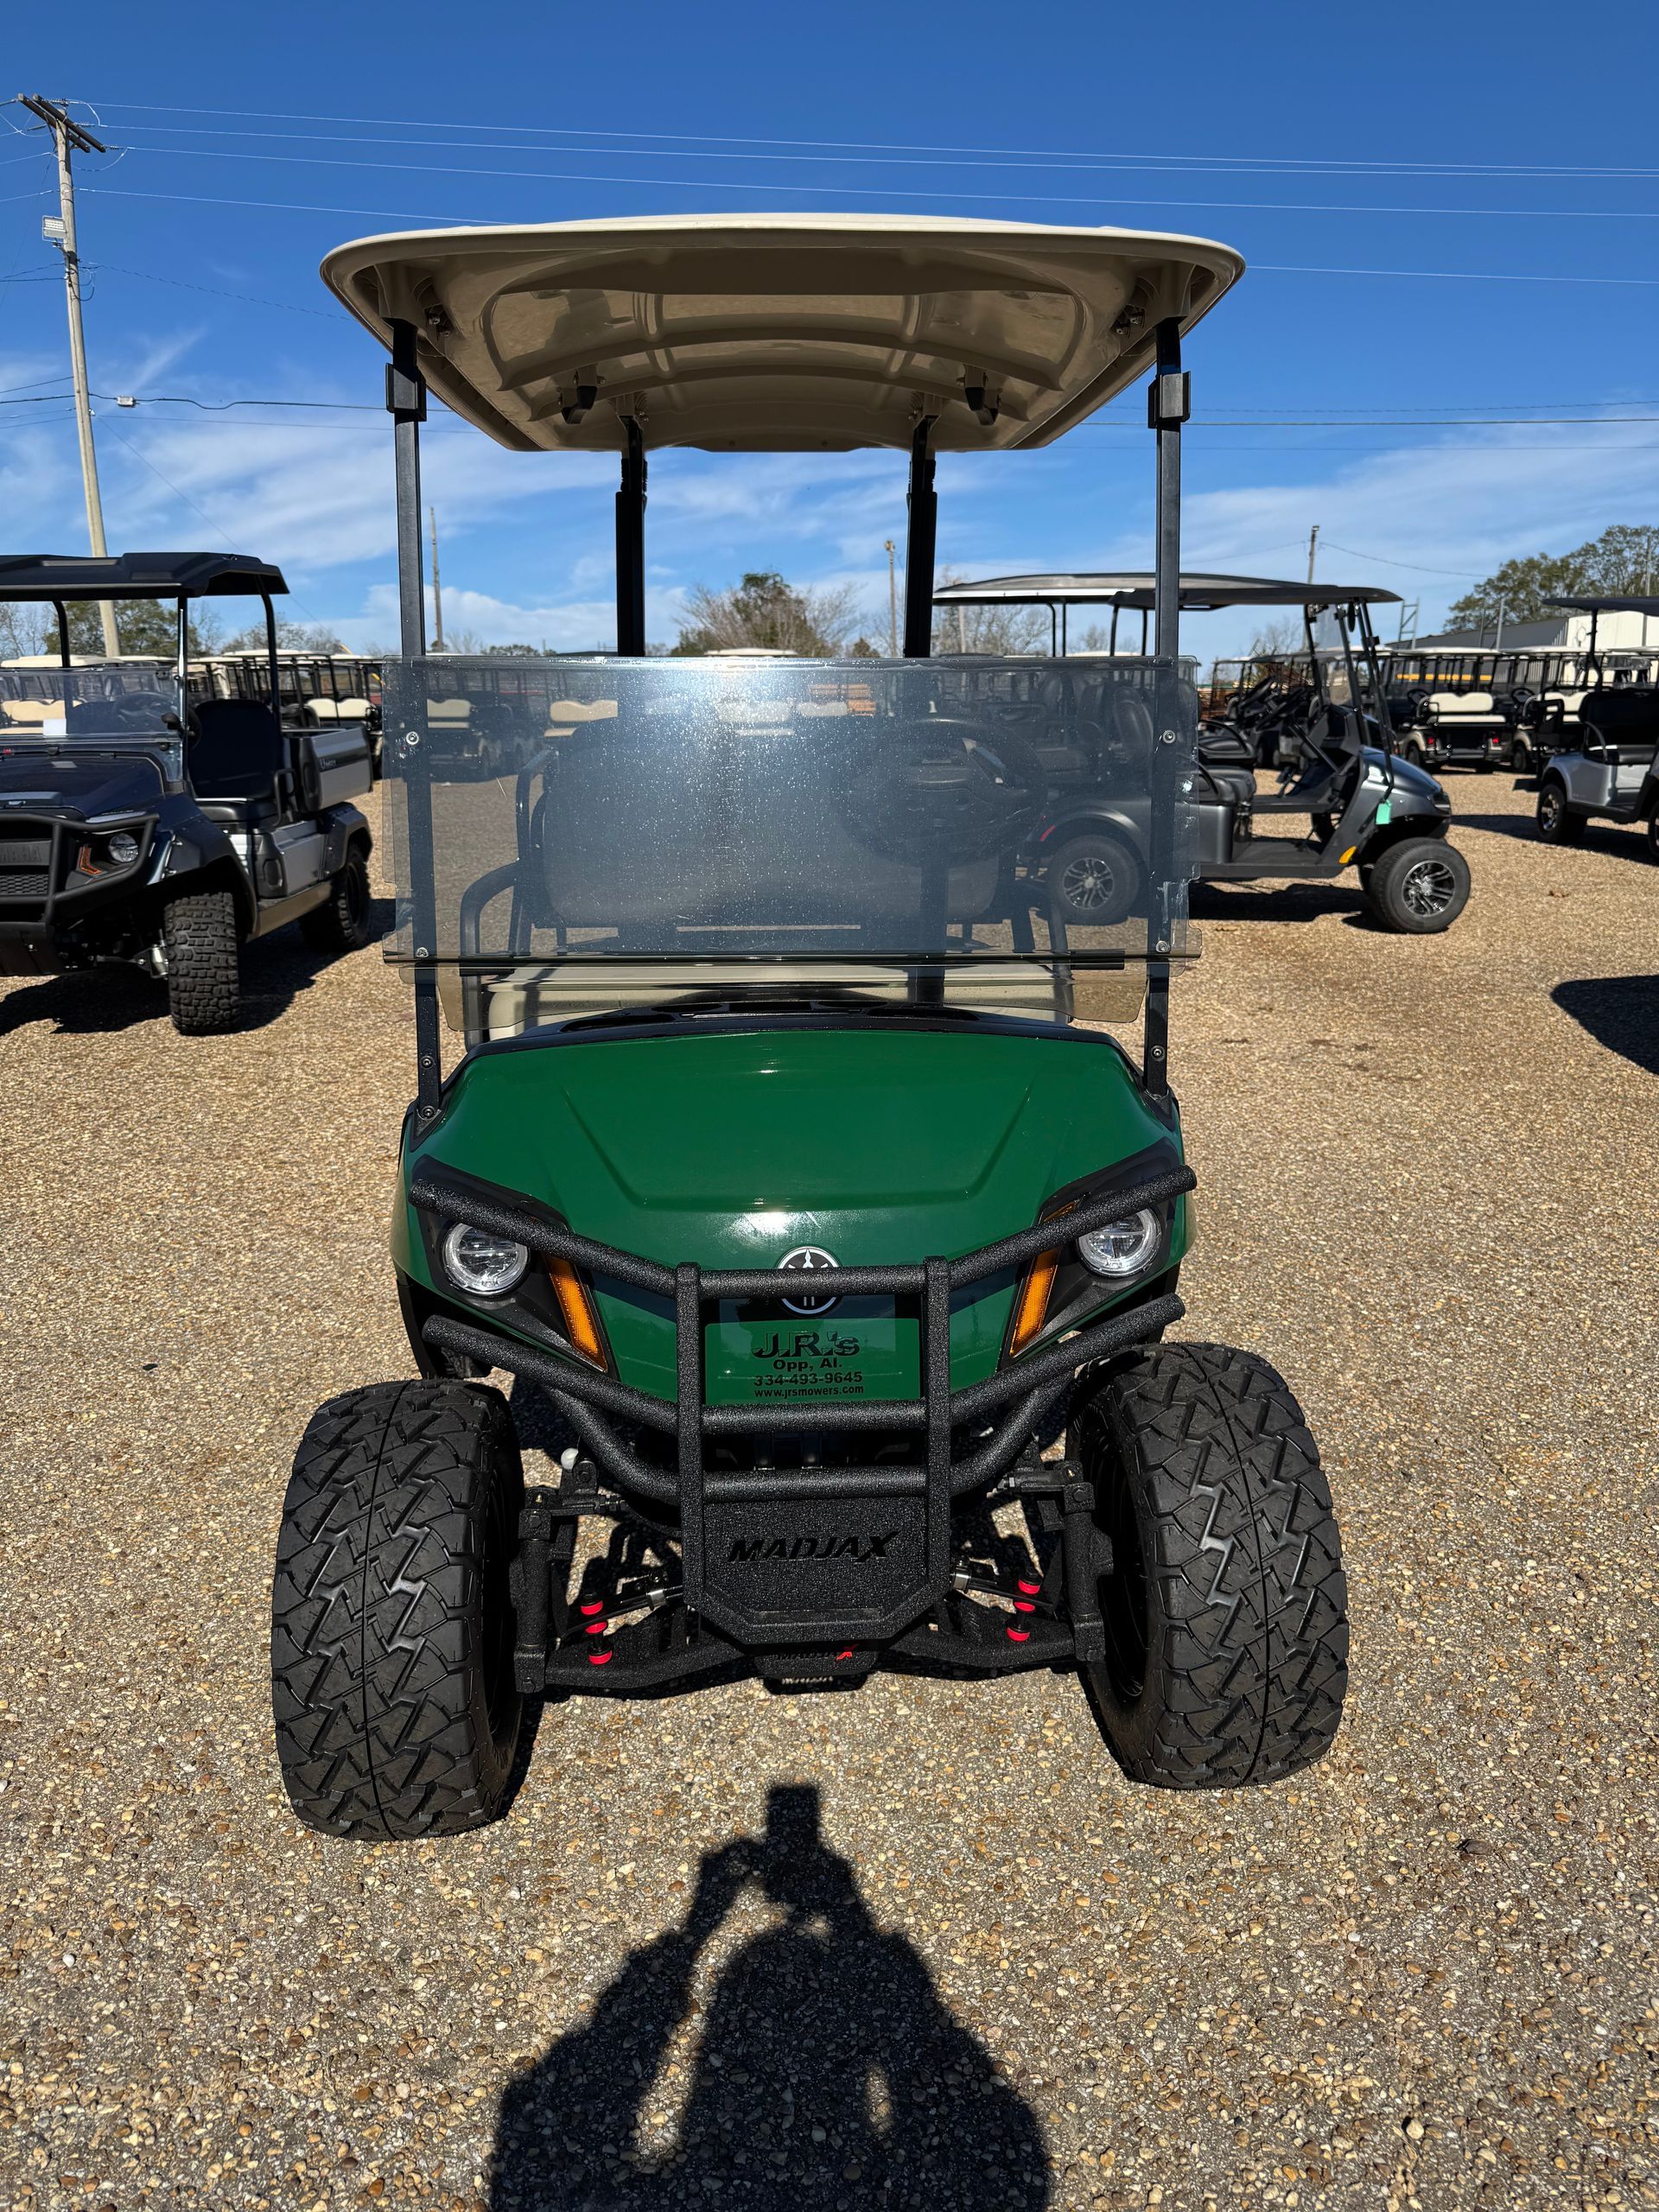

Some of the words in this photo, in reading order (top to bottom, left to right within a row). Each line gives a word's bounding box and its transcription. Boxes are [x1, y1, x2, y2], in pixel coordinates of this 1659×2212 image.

[752, 1331, 861, 1357] J.R.'s
[772, 1359, 813, 1372] Opp,
[753, 1371, 863, 1386] 334-493-9645
[754, 1385, 864, 1399] www.jrsmowers.com
[728, 1531, 899, 1562] MADJAX
